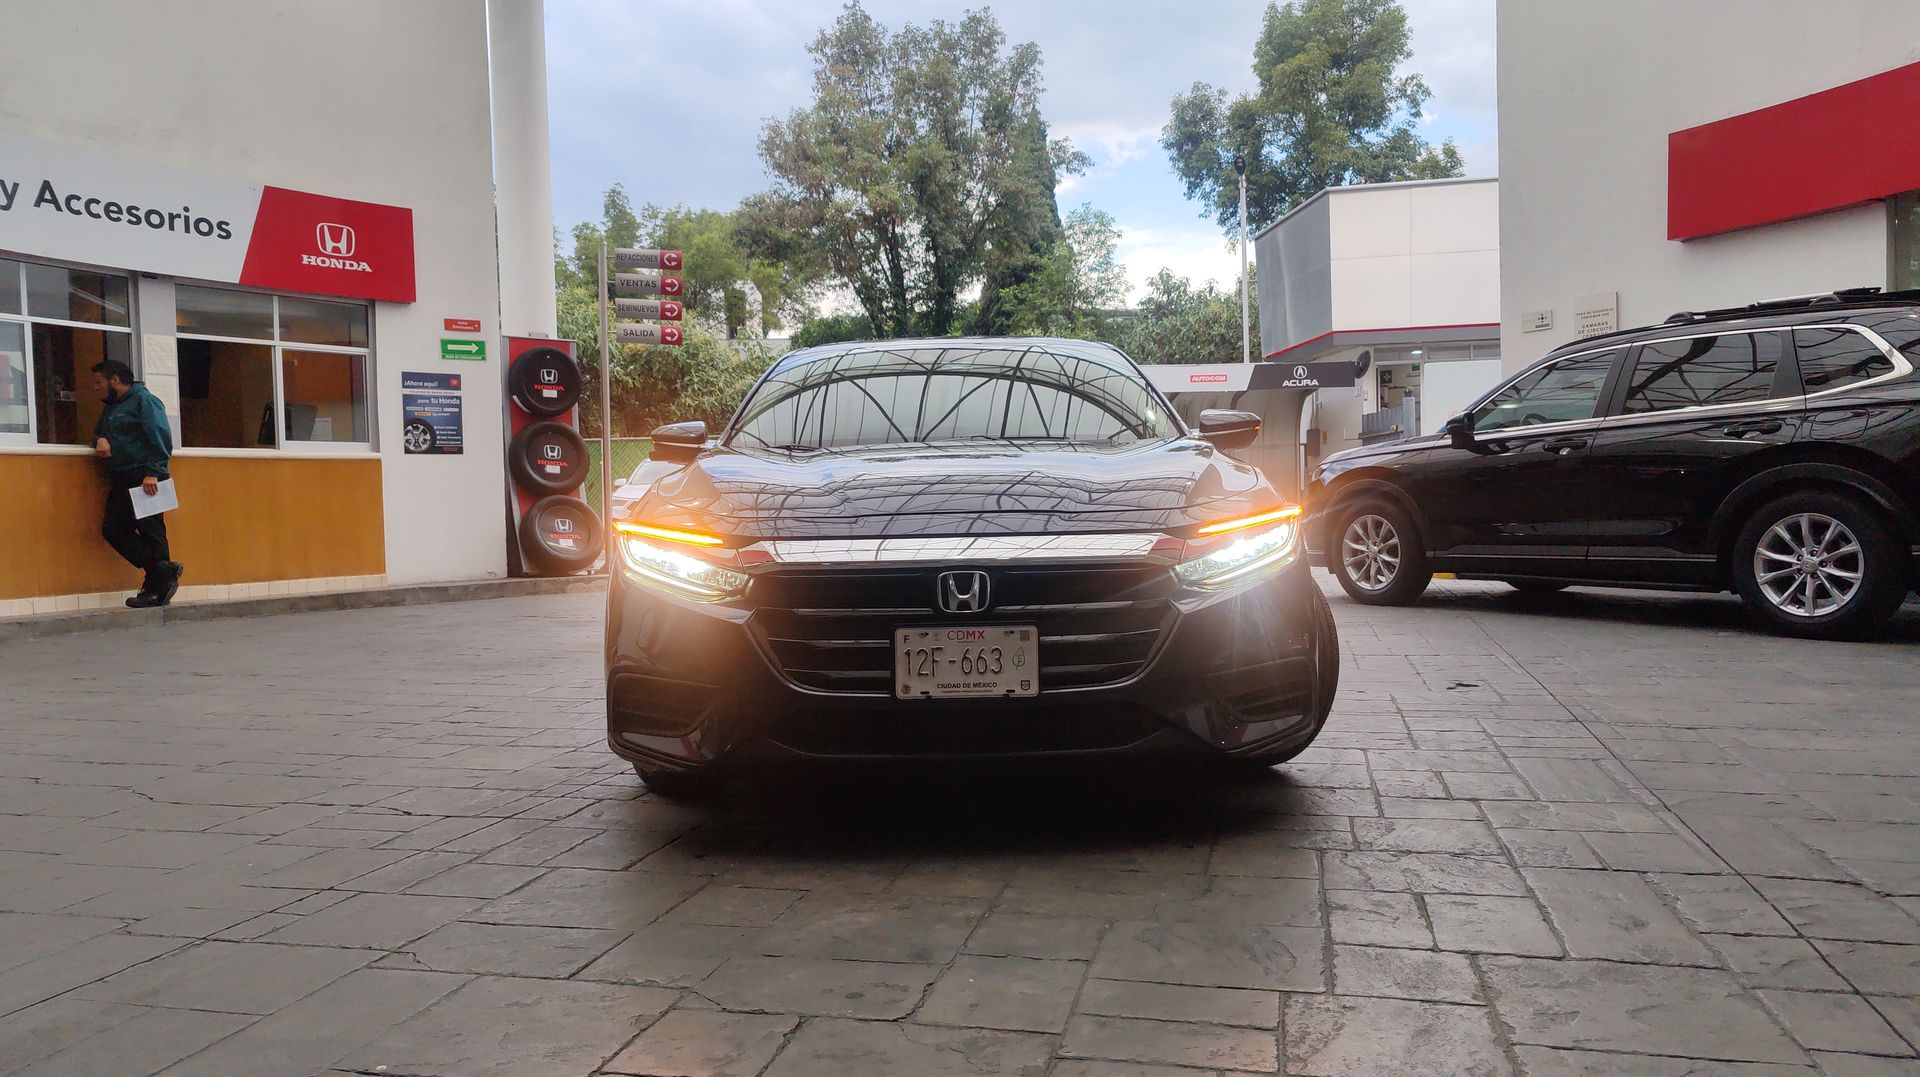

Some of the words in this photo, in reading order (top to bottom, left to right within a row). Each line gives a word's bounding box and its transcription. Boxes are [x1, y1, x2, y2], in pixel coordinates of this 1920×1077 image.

[0, 179, 20, 211] y
[33, 180, 232, 240] Accesorios
[301, 254, 372, 272] HONDA
[616, 253, 658, 263] REFACCIONES
[620, 279, 657, 289] VENTAS
[617, 304, 658, 313] SEMINUEVOS
[623, 328, 655, 337] SALIDA
[534, 384, 565, 392] HONDA
[1282, 379, 1319, 387] ACURA
[947, 630, 986, 641] CDMX
[904, 646, 1003, 678] 12F-663
